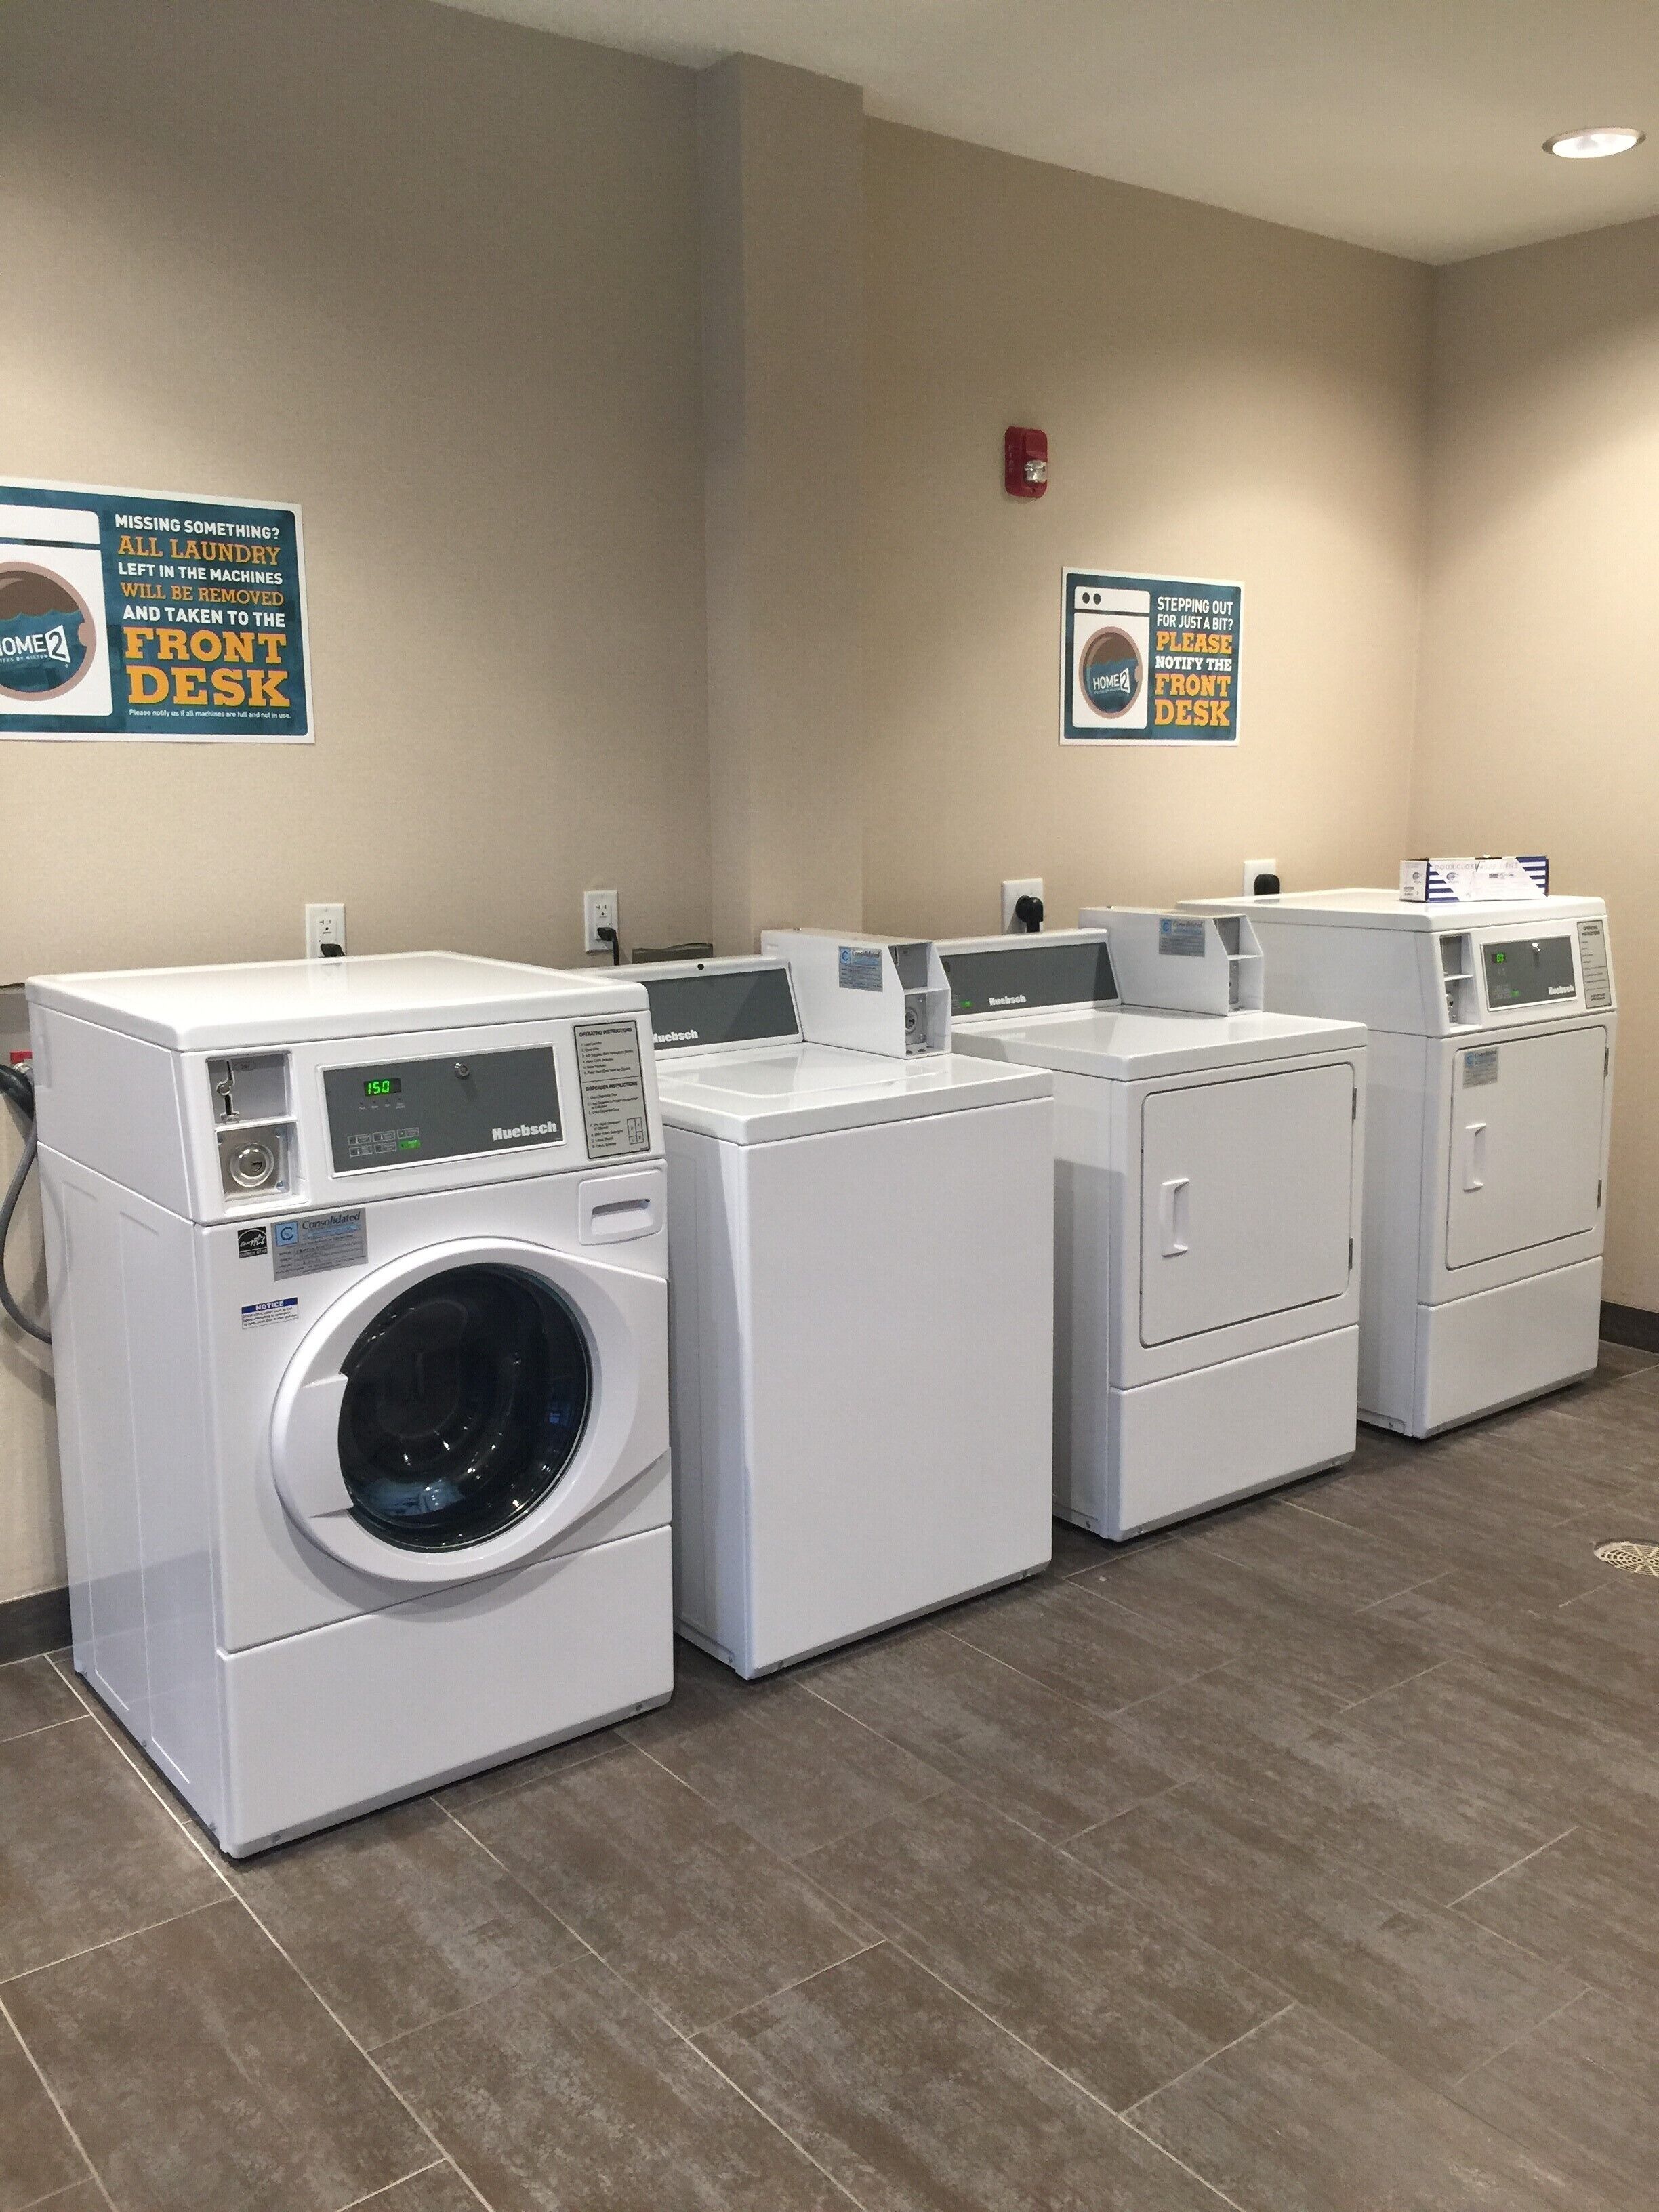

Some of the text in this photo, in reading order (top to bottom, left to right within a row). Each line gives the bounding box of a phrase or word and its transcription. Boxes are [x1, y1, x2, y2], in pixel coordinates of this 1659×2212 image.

[115, 514, 280, 540] MISSING SOMETHING?
[118, 535, 281, 565] ALL LAUNDRY
[119, 562, 283, 585] LEFT IN THE MACHINES
[120, 581, 284, 607] WILL BE REMOVED
[1156, 596, 1233, 615] STEPPING OUT
[123, 605, 285, 628] AND TAKEN TO THE
[1156, 613, 1233, 631] FOR JUST A BIT?
[0, 627, 69, 661] OME2
[123, 626, 287, 665] FRONT
[1156, 630, 1233, 654] PLEASE
[1155, 655, 1232, 672] NOTIFY THE
[126, 664, 291, 708] DESK
[1154, 674, 1231, 697] FRONT
[129, 708, 151, 716] Please
[152, 709, 170, 717] notify
[1154, 699, 1231, 727] DESK
[989, 994, 1027, 1006] Huebsch
[368, 1080, 390, 1094] 150
[491, 1120, 557, 1141] Huebsch
[302, 1211, 361, 1230] Consolidated
[255, 1300, 284, 1311] NOTICE
